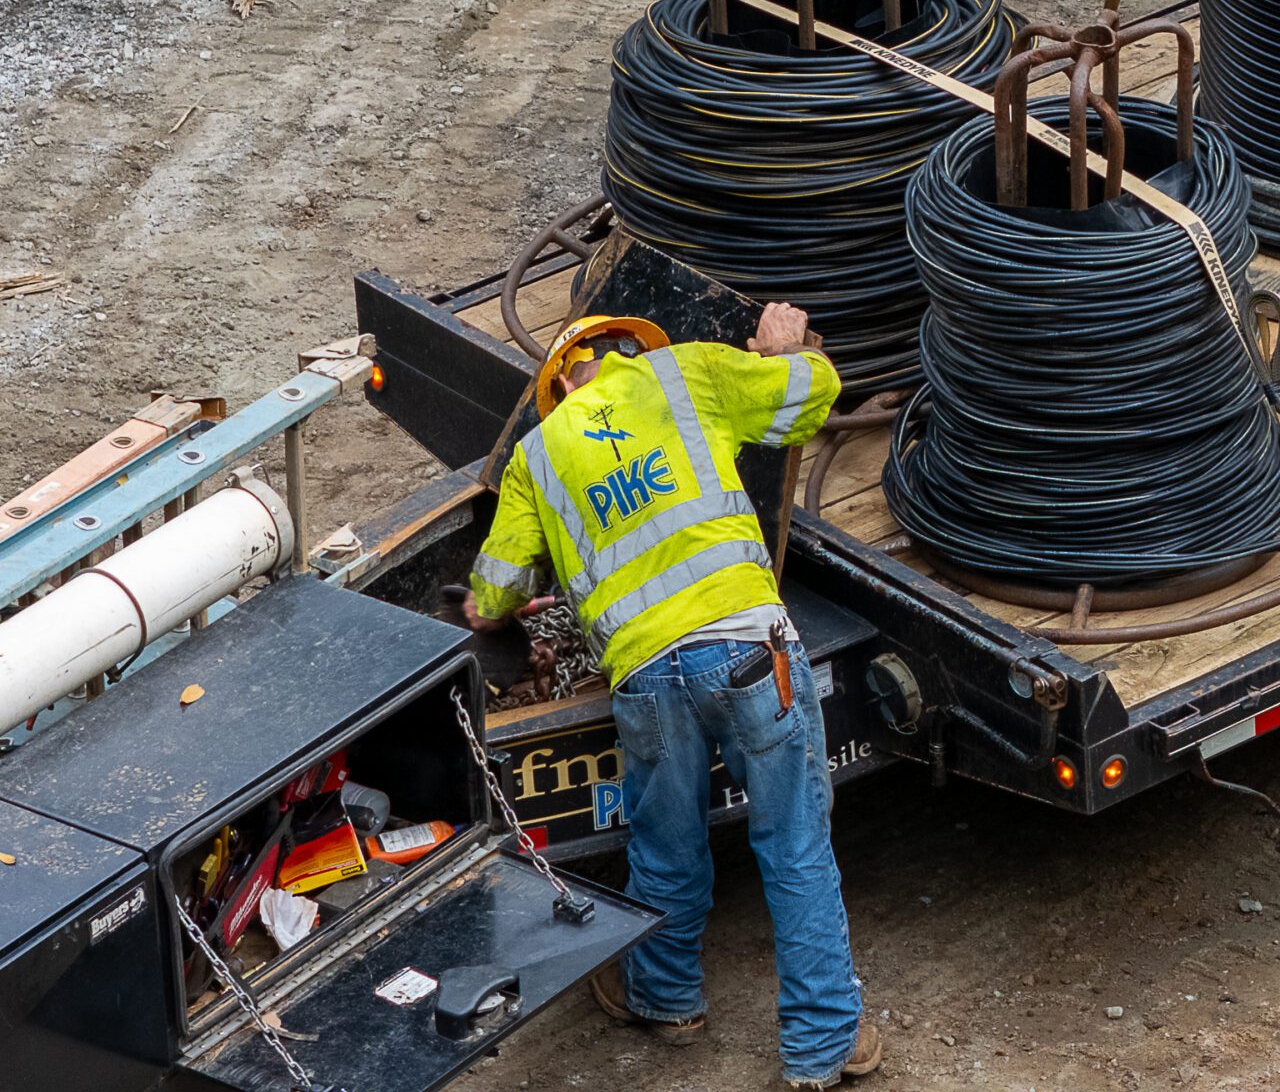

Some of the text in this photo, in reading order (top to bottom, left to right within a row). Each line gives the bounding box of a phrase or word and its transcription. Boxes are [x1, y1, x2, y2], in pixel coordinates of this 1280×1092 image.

[873, 49, 937, 79] KINEDYNE
[1207, 257, 1243, 328] KINEDYN
[583, 445, 680, 533] PIKE
[513, 748, 624, 801] fm
[827, 740, 873, 772] sile
[593, 778, 631, 831] PI
[91, 900, 129, 935] Buyers
